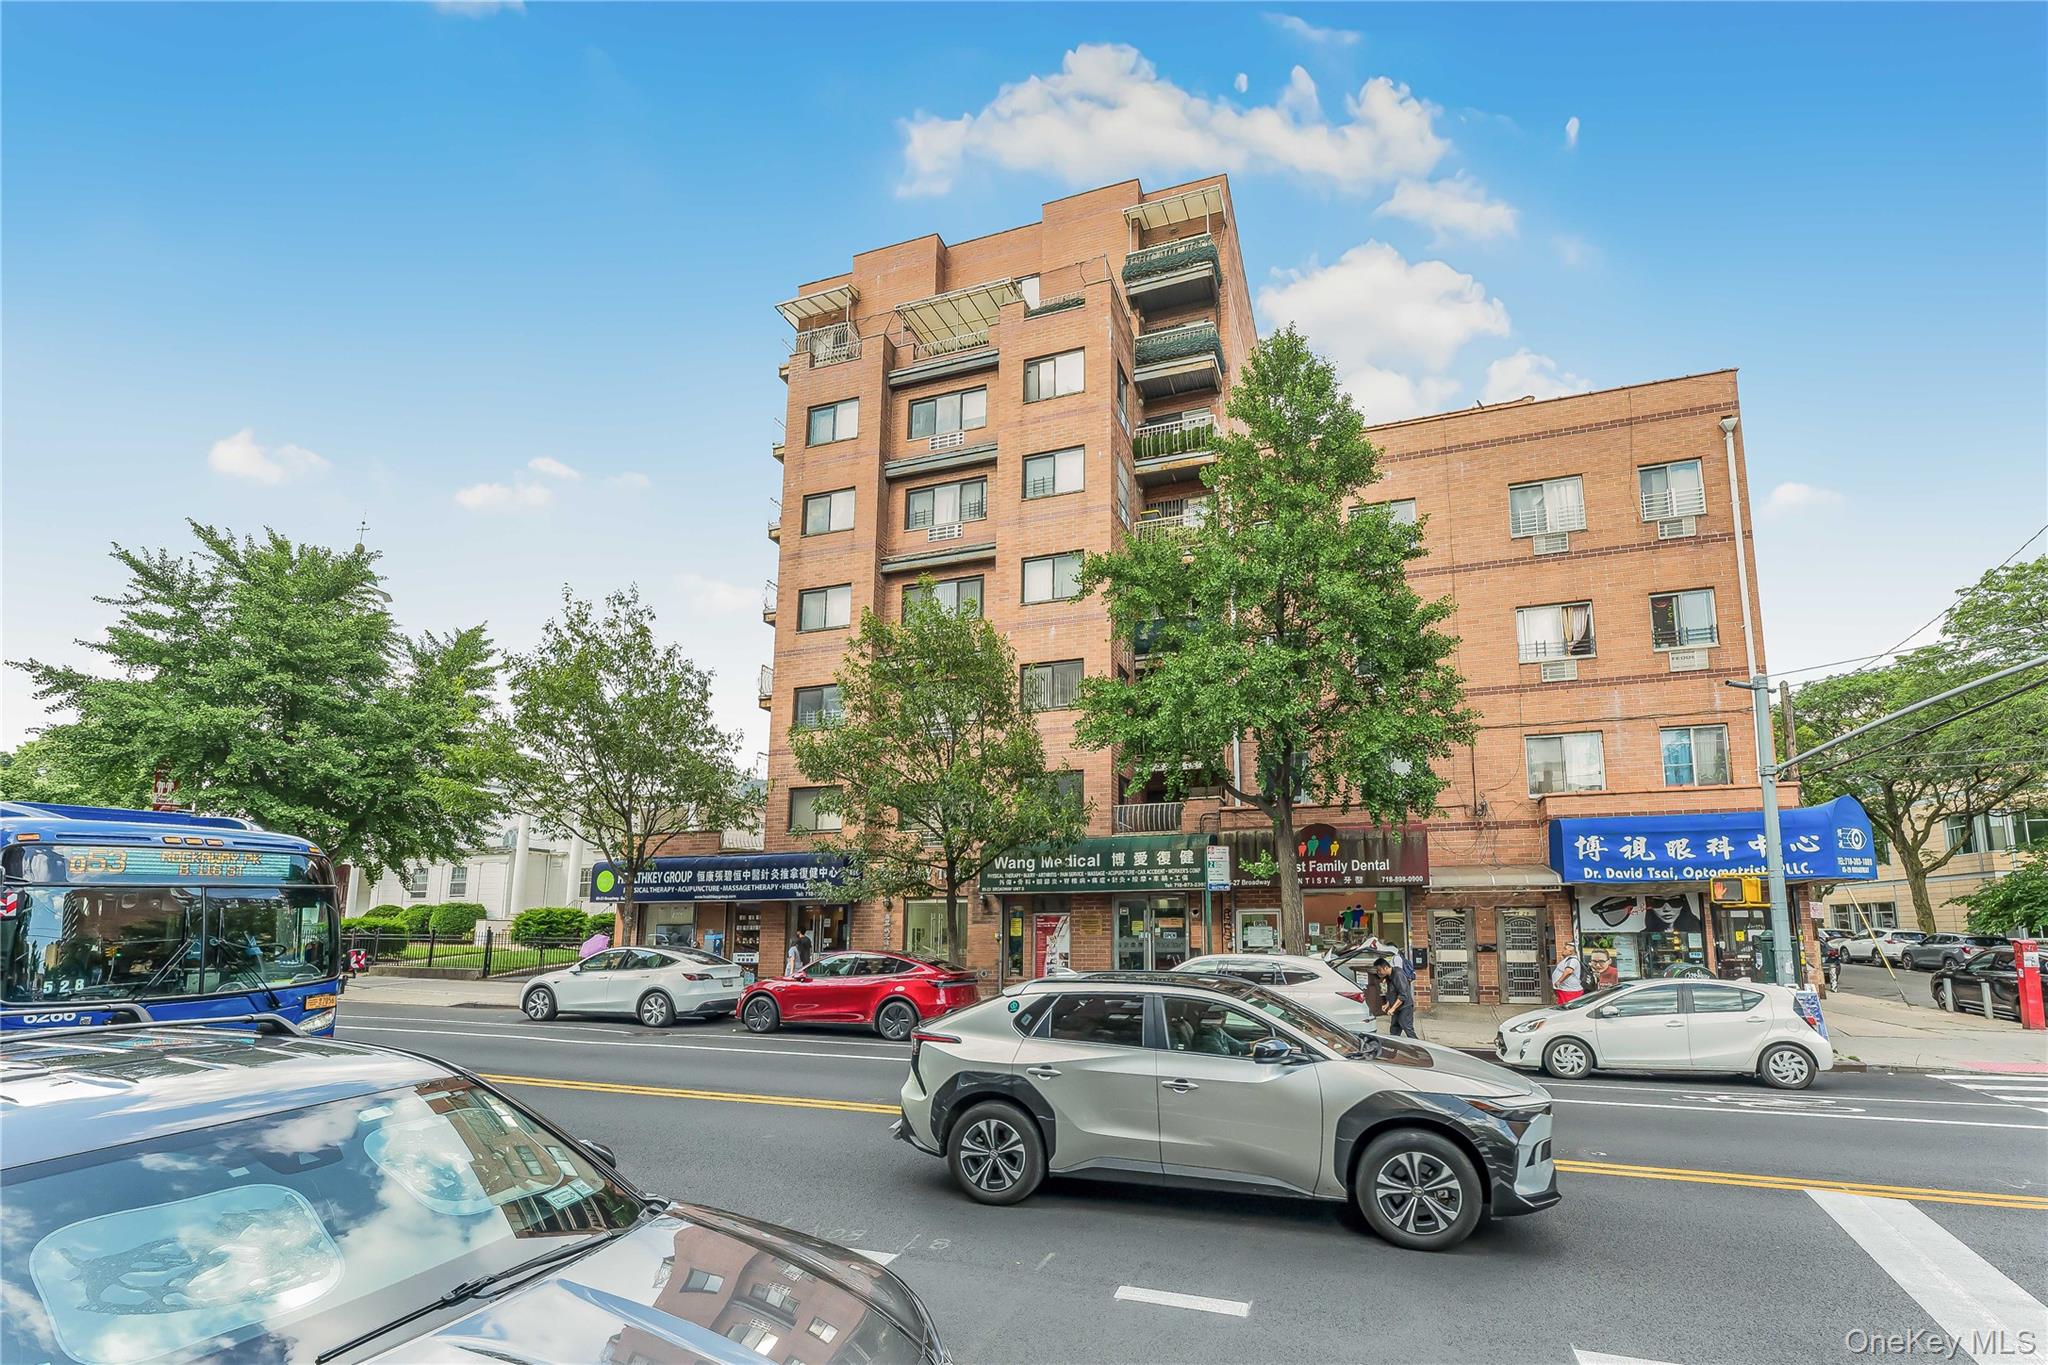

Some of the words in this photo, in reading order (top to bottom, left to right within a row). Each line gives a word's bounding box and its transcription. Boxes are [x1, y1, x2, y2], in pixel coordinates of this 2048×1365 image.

[1574, 834, 1820, 861] 博視眼科中心
[160, 850, 239, 864] ROCKAWAY
[243, 853, 263, 864] PK
[994, 856, 1035, 872] Wang
[1041, 853, 1100, 868] Medical
[1112, 850, 1194, 867] 博愛復健
[1309, 860, 1348, 873] Family
[1351, 859, 1390, 871] Dental
[663, 870, 693, 884] GROUP
[1583, 867, 1602, 878] Dr.
[1605, 867, 1643, 879] David
[1647, 867, 1678, 880] Tsai,
[677, 885, 720, 893] ACUPUNCTURE
[1241, 879, 1271, 887] Broadway
[43, 978, 85, 994] 528
